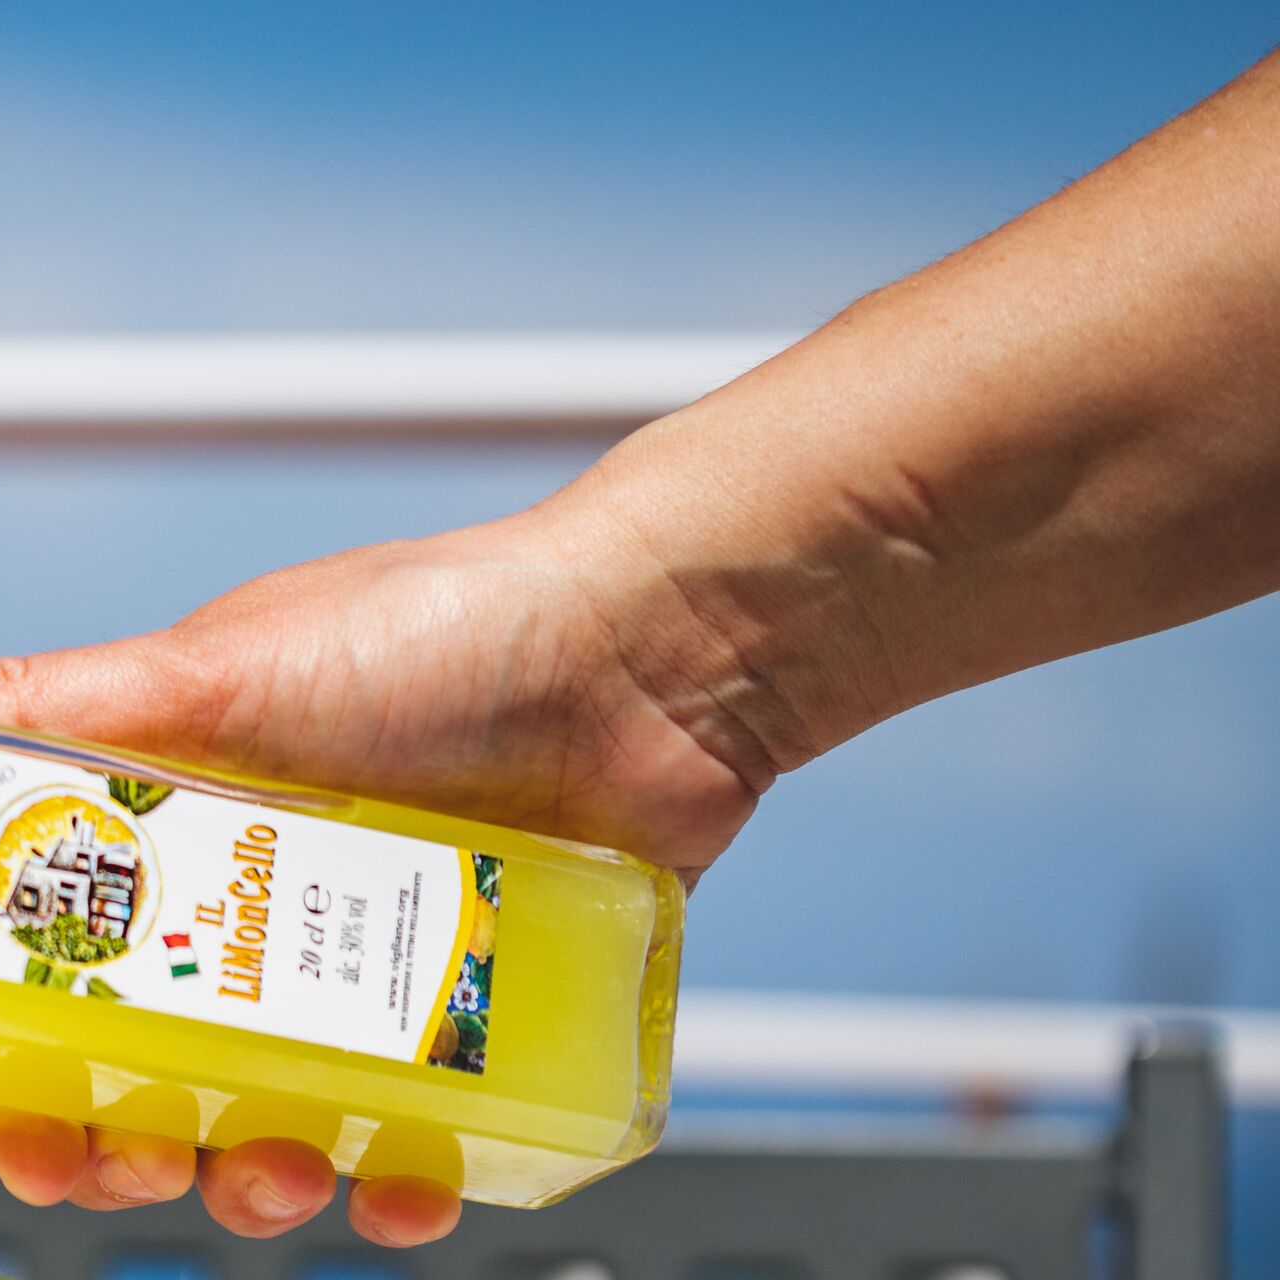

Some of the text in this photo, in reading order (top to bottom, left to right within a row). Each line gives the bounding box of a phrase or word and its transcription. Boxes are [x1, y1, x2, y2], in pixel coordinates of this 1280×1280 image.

[194, 899, 226, 928] IL
[299, 949, 323, 982] 20
[388, 888, 410, 1010] www.vigliano.org
